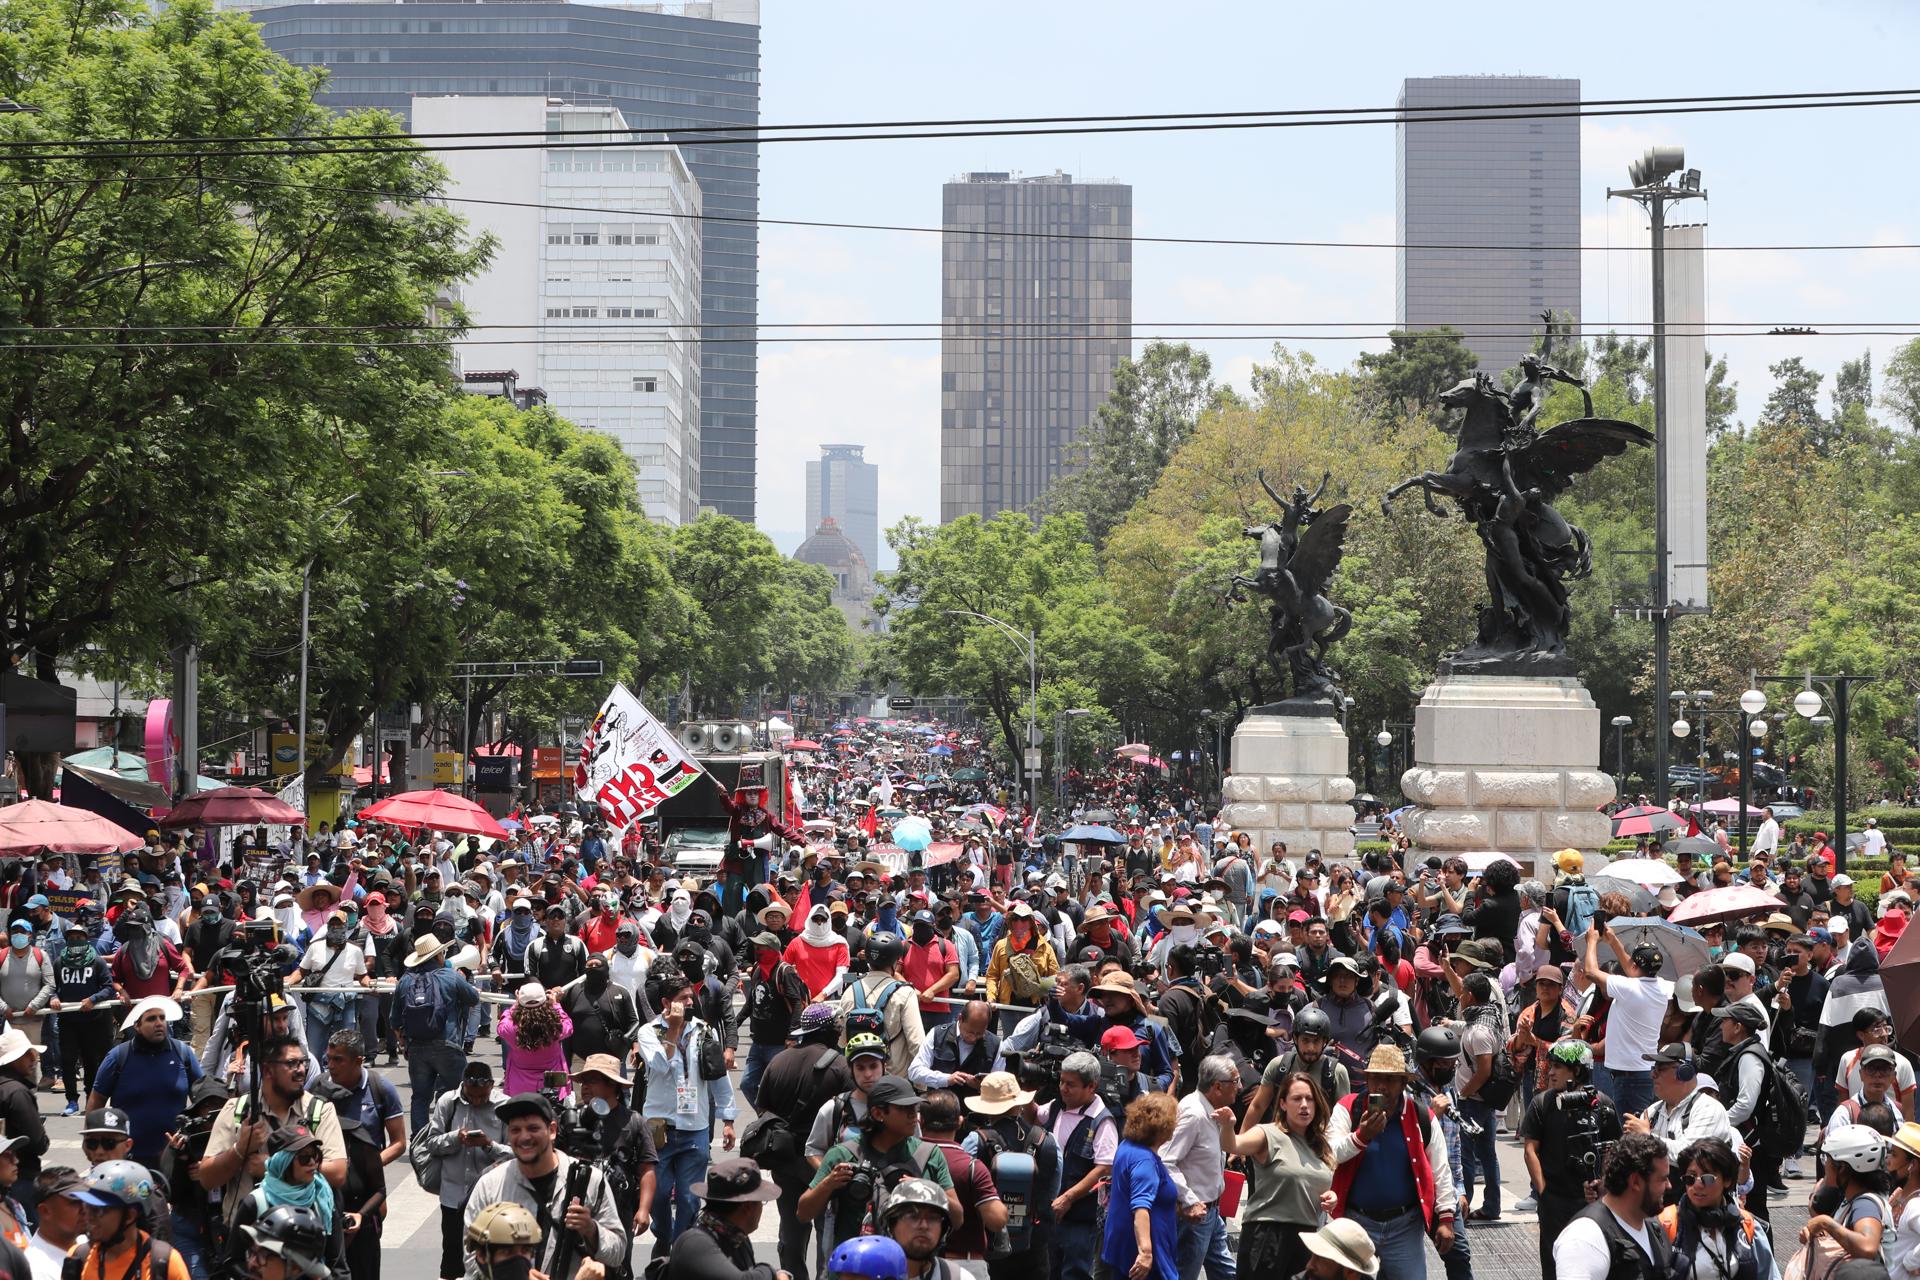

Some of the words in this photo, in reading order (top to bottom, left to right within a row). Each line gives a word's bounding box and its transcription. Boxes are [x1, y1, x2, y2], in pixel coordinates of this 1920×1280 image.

[480, 766, 504, 774] telcel
[61, 966, 93, 984] GAP
[1003, 1194, 1024, 1202] LiveU
